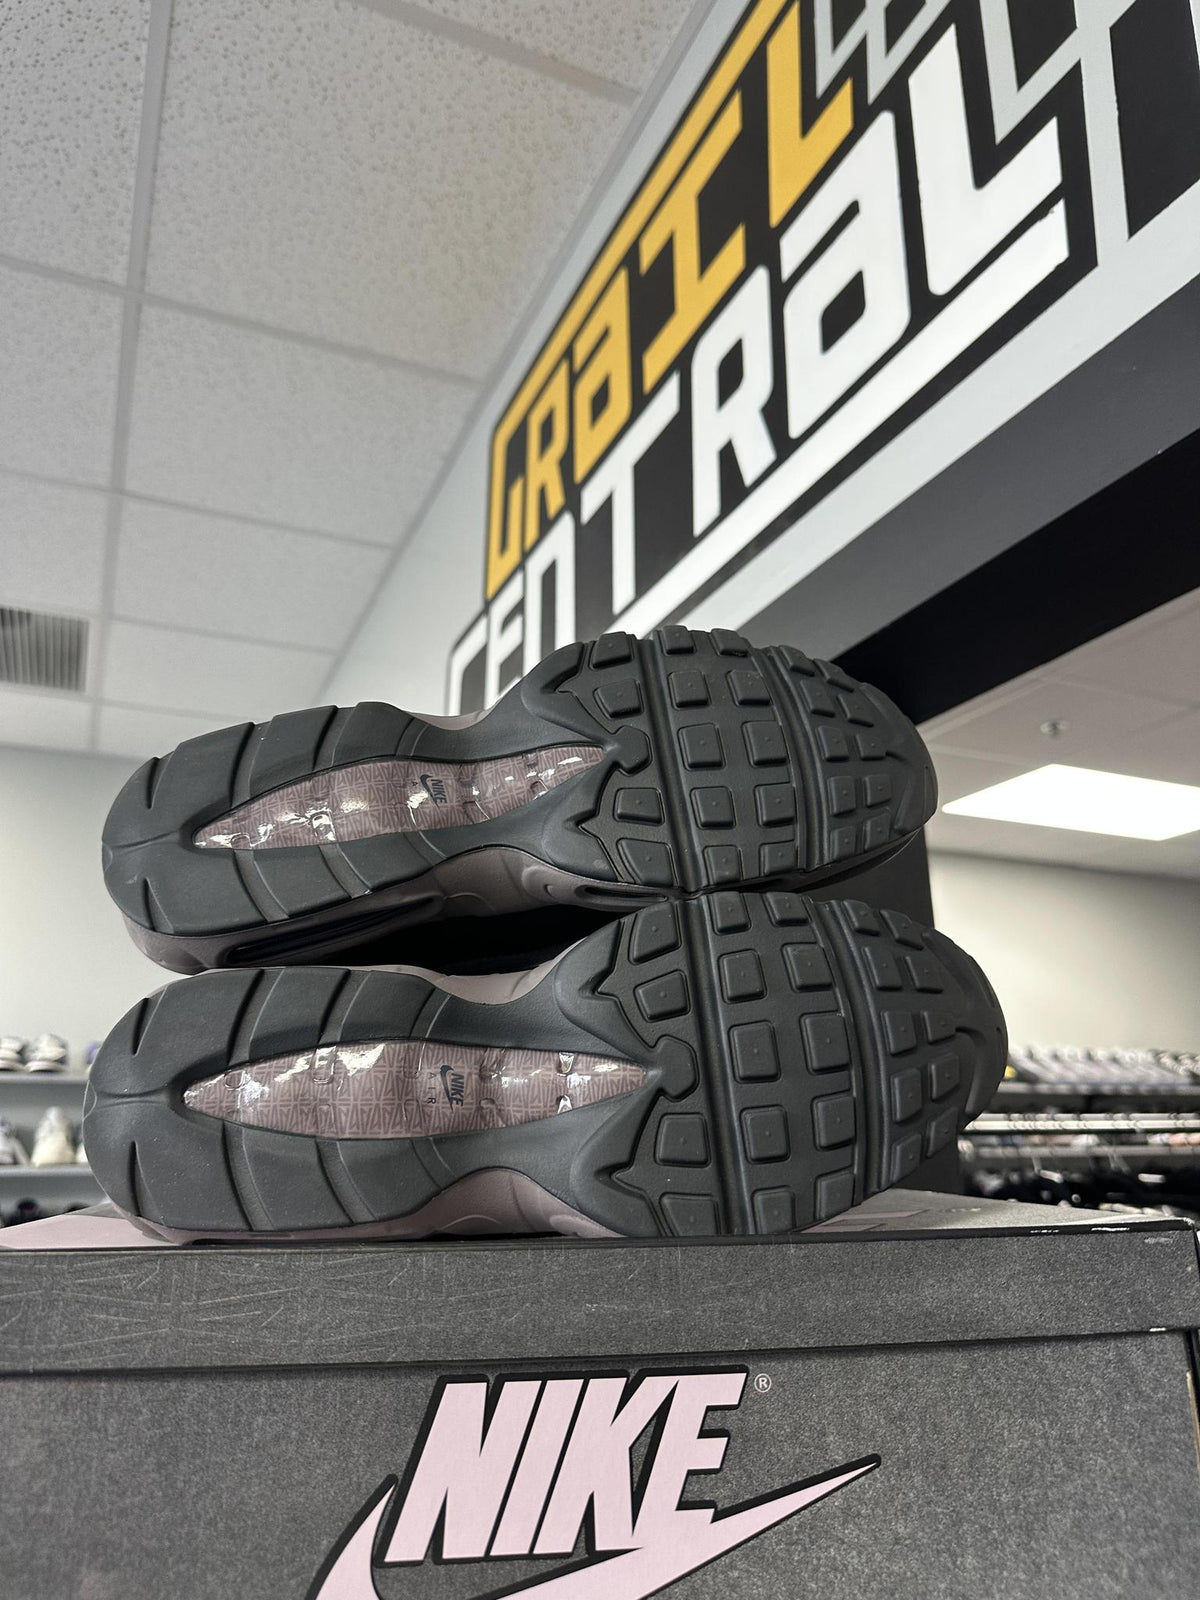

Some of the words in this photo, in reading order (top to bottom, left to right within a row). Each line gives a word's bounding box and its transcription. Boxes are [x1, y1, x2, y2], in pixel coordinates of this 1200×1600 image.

[431, 779, 447, 803] NIKE
[451, 1073, 464, 1106] NIKE
[380, 1368, 748, 1563] NIKE
